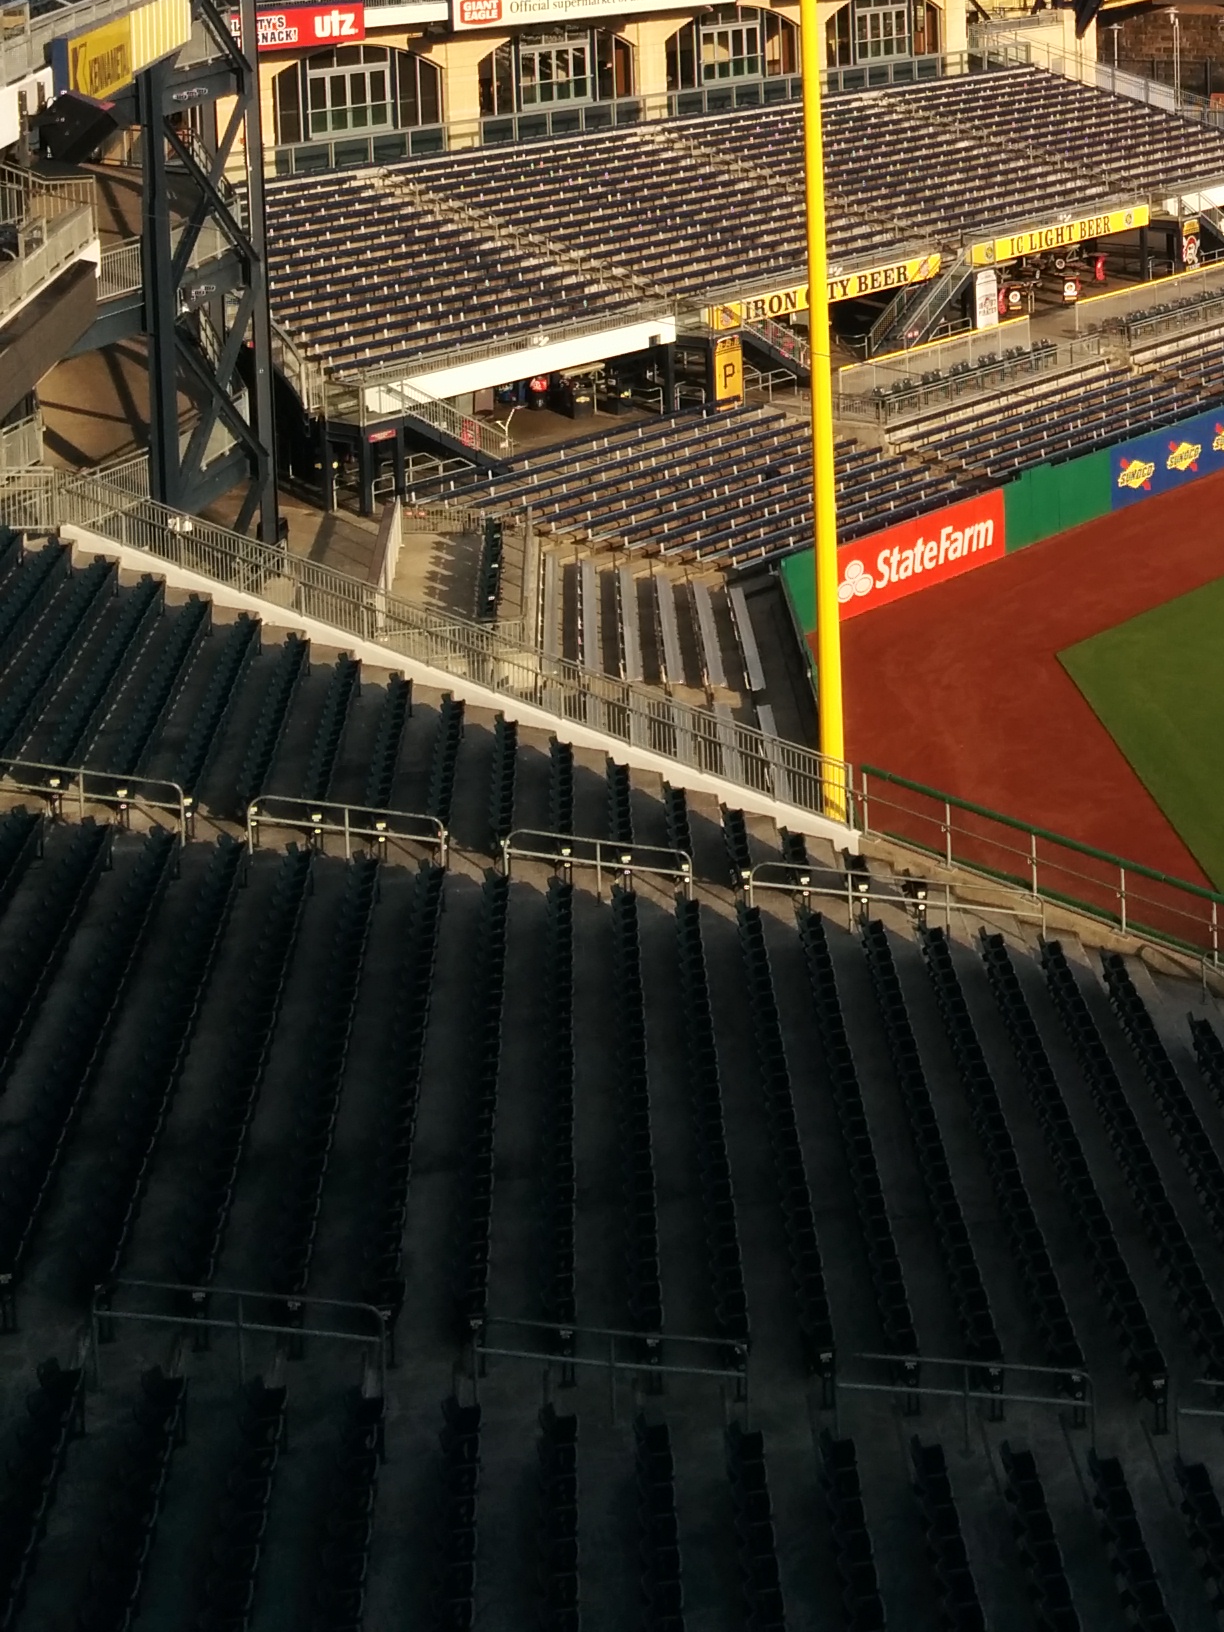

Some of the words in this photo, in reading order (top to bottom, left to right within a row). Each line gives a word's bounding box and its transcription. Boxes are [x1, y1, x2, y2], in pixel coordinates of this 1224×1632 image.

[464, 0, 498, 11] GIANT
[464, 10, 498, 21] EAGLE
[314, 10, 355, 38] utz
[1010, 236, 1023, 256] IC
[1029, 224, 1075, 251] LIGHT
[1080, 215, 1111, 238] BEER
[746, 291, 798, 319] IRON
[857, 266, 908, 292] BEER
[1168, 445, 1202, 468] SUNOCO
[1120, 463, 1155, 486] SUNOCO
